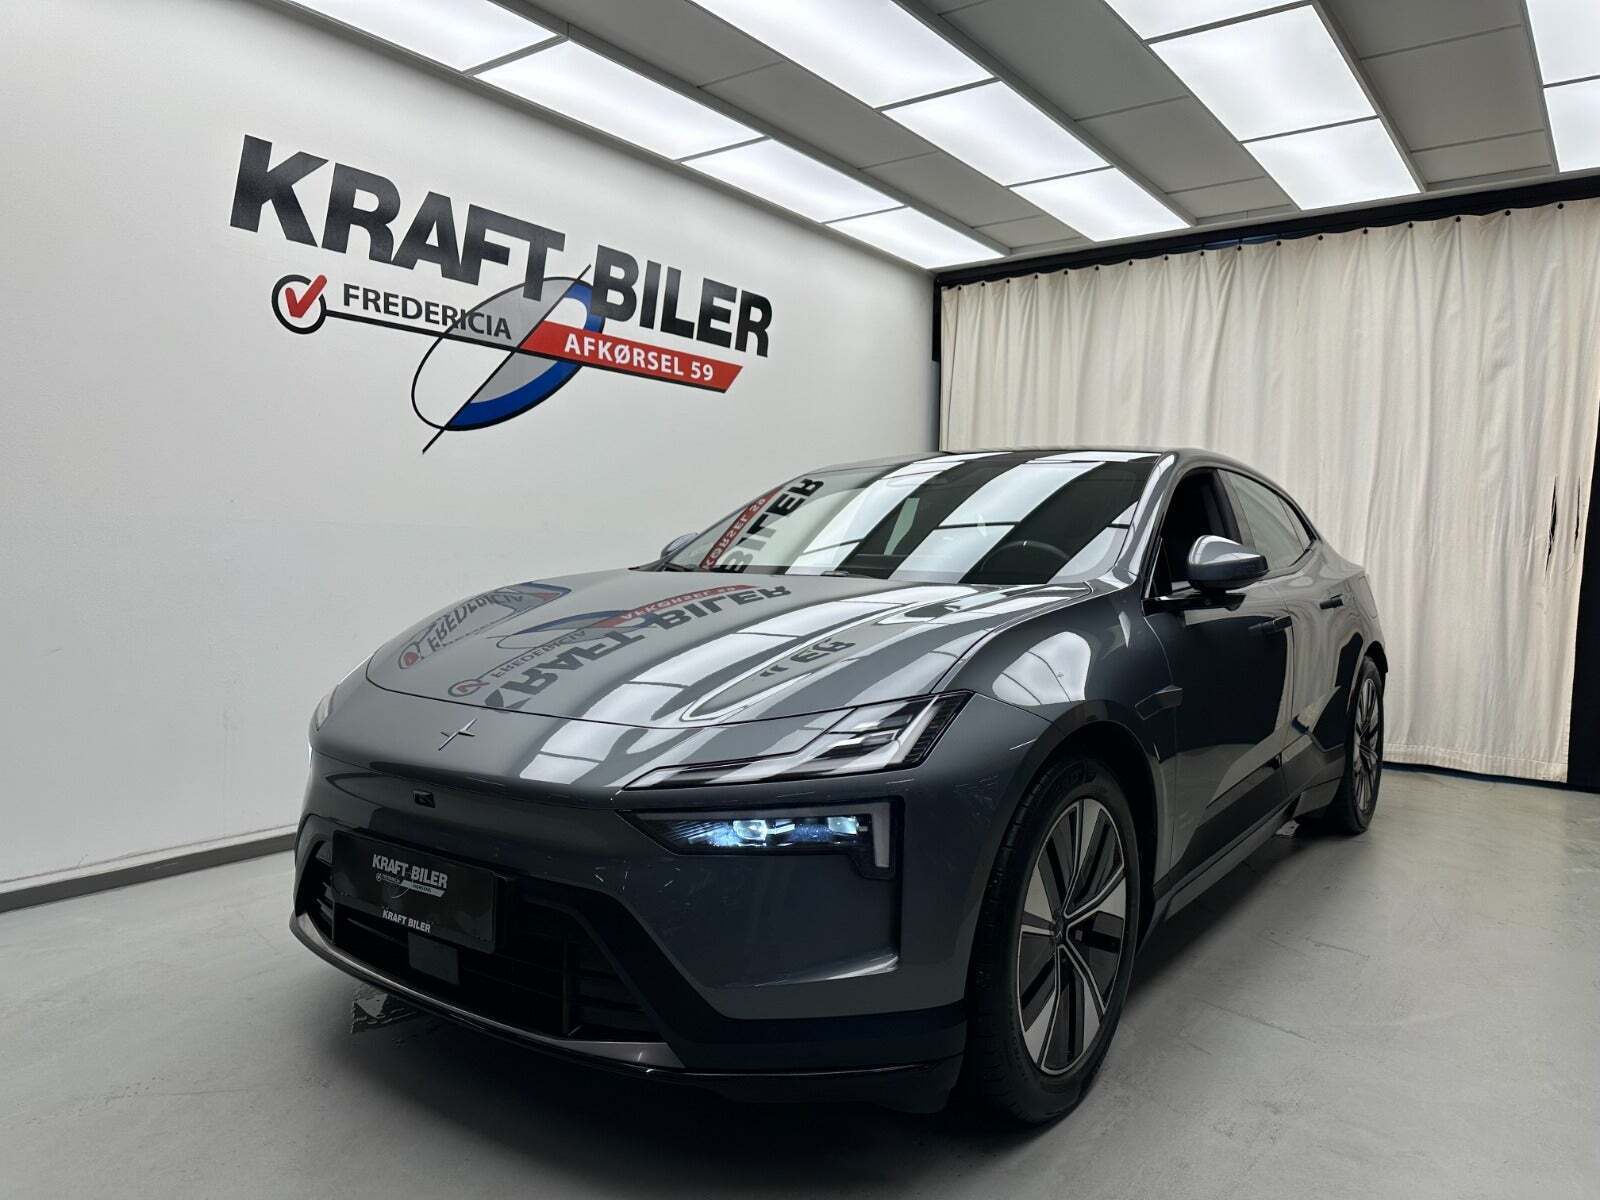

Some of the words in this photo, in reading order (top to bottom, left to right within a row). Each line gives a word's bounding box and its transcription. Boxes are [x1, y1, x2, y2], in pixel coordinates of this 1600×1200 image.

[230, 134, 566, 302] KRAFT
[590, 244, 773, 358] BILER
[343, 284, 512, 340] FREDERICIA
[564, 333, 684, 377] AFKØRSEL
[690, 360, 715, 381] 59
[372, 853, 409, 877] KRAFT
[411, 865, 448, 889] BILER
[382, 909, 407, 925] KRAFT
[408, 918, 431, 933] BILER
